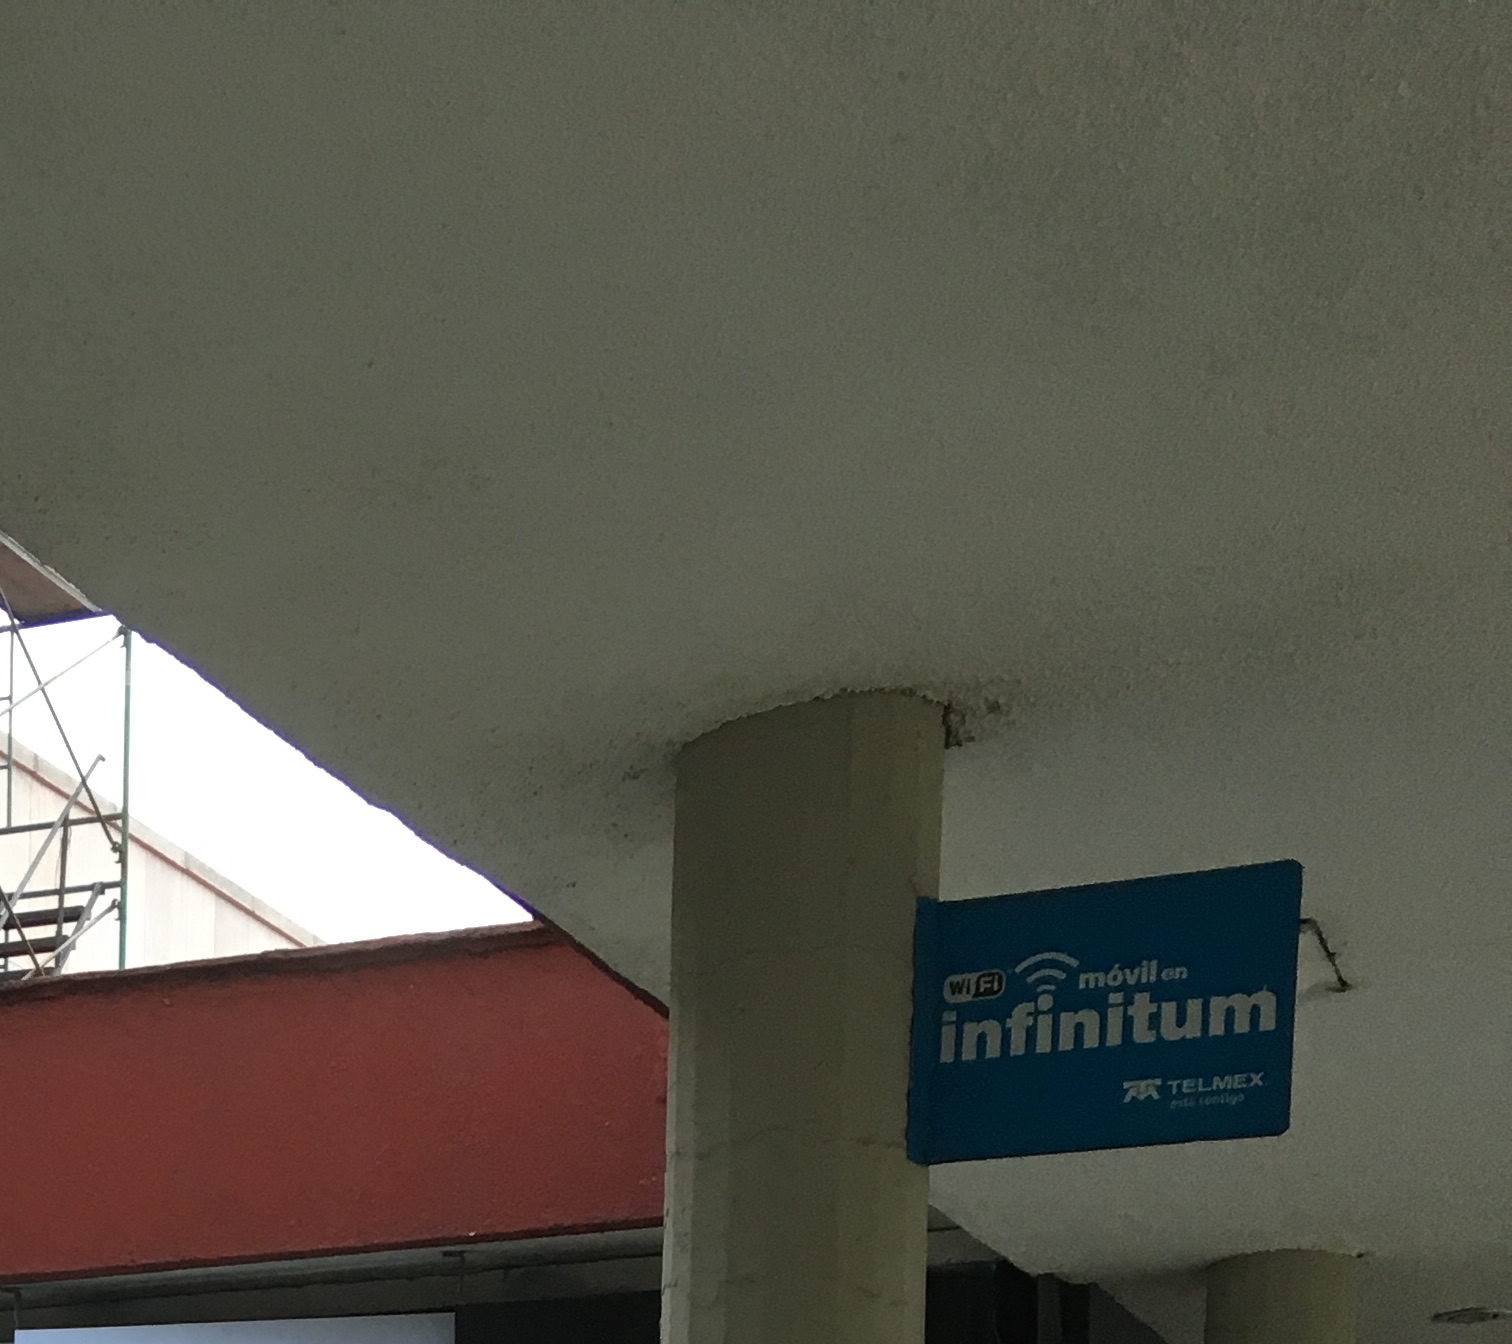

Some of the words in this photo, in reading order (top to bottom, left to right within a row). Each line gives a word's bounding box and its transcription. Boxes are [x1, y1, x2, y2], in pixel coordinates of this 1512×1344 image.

[1079, 959, 1158, 990] móvil
[1161, 965, 1188, 982] en
[939, 988, 1278, 1064] infinitum
[1167, 1071, 1264, 1095] TELMEX
